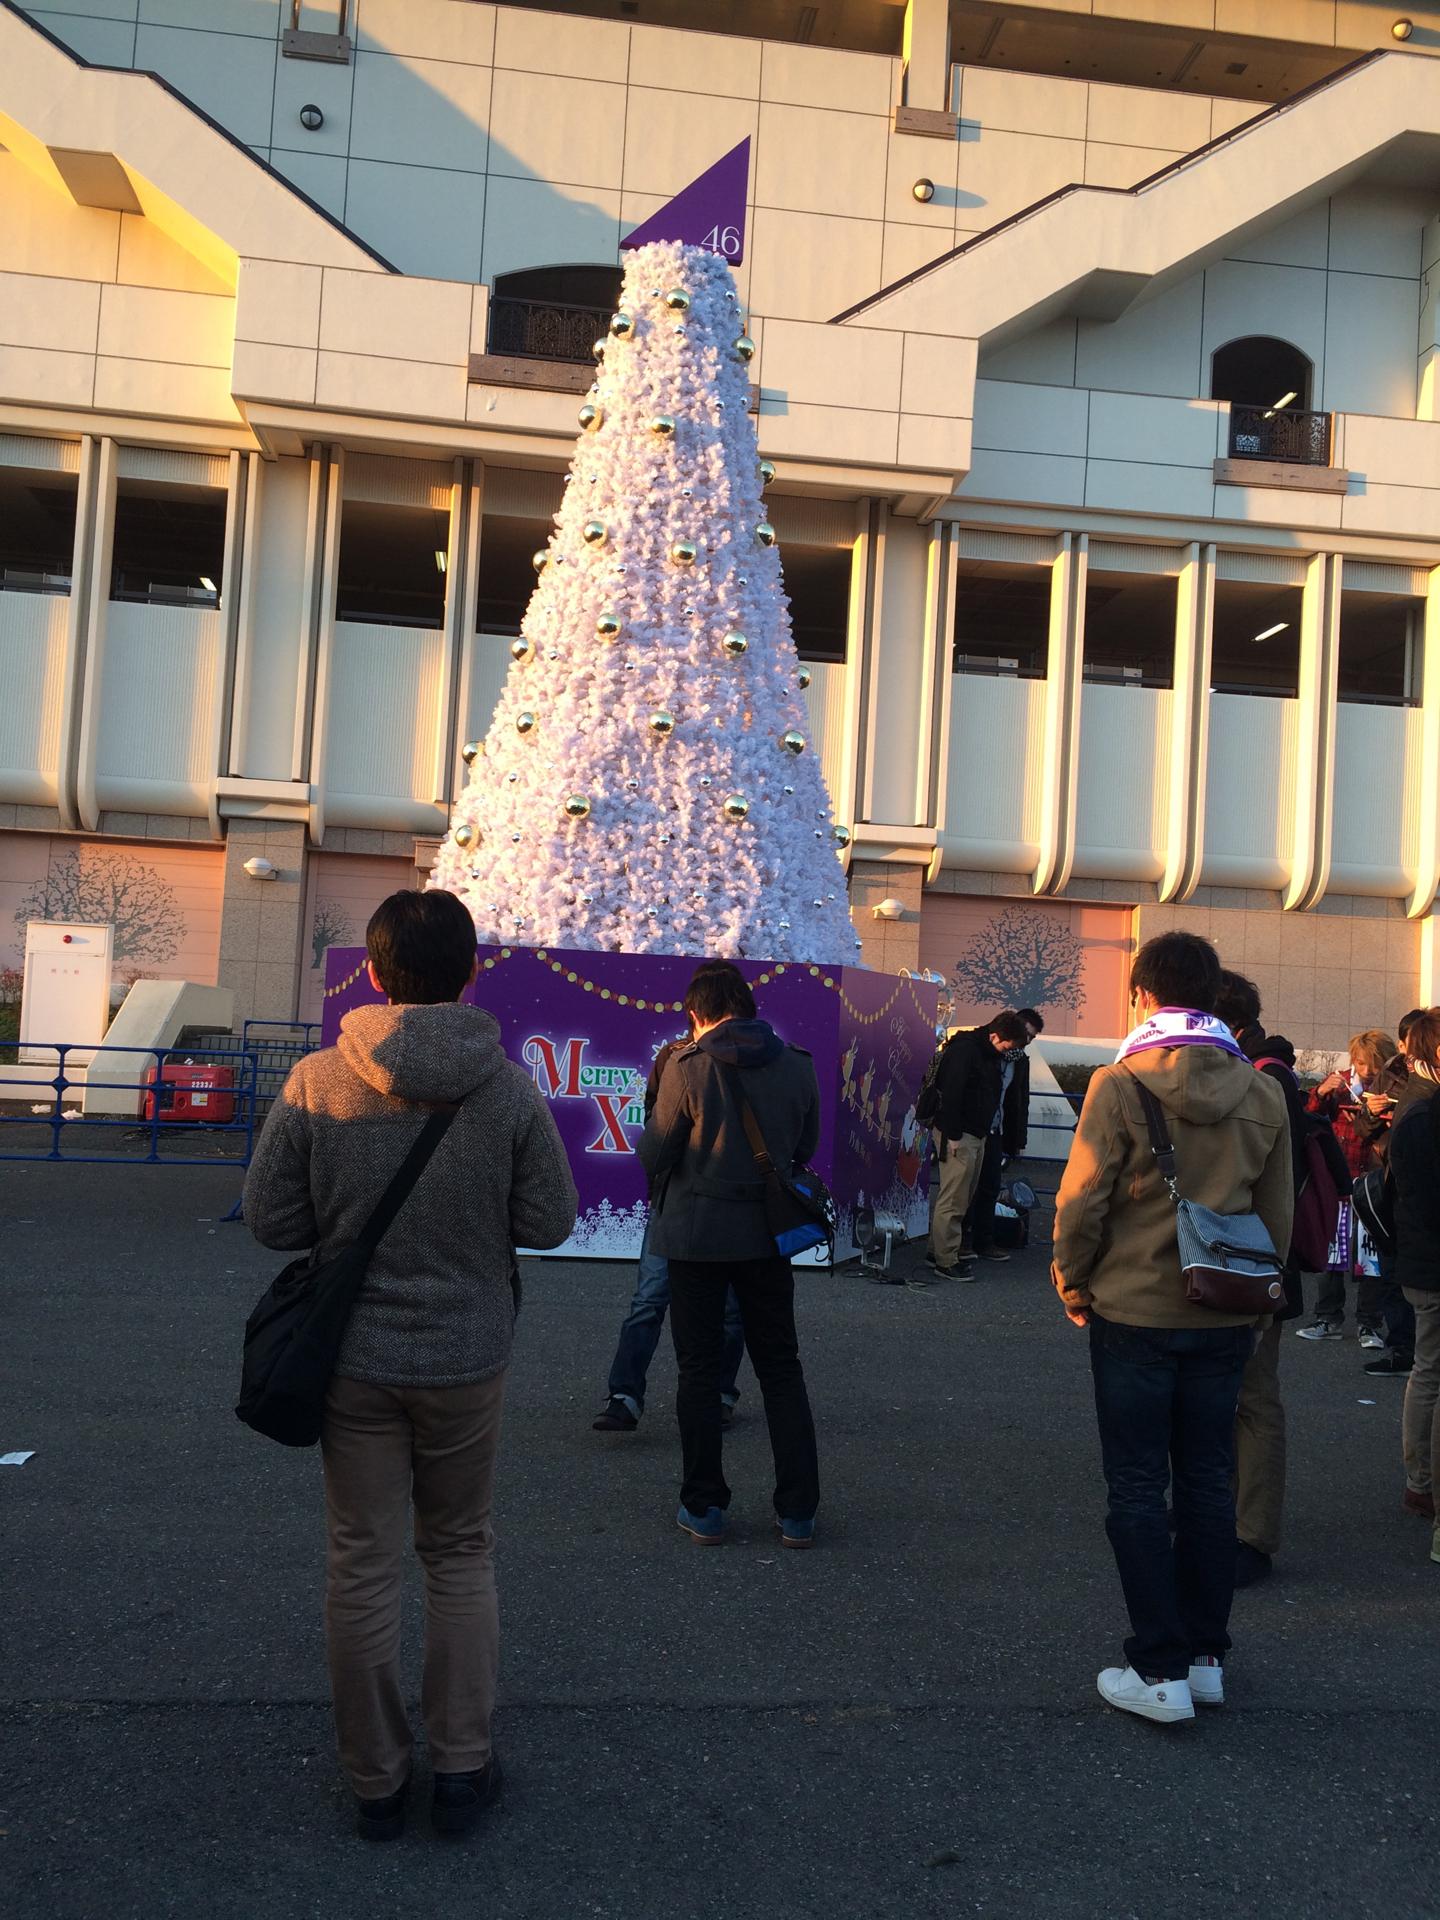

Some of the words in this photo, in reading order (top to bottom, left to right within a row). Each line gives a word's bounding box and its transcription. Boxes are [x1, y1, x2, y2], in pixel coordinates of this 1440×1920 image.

[700, 224, 740, 255] 46
[522, 1035, 637, 1098] Merry
[585, 1093, 645, 1154] Xm
